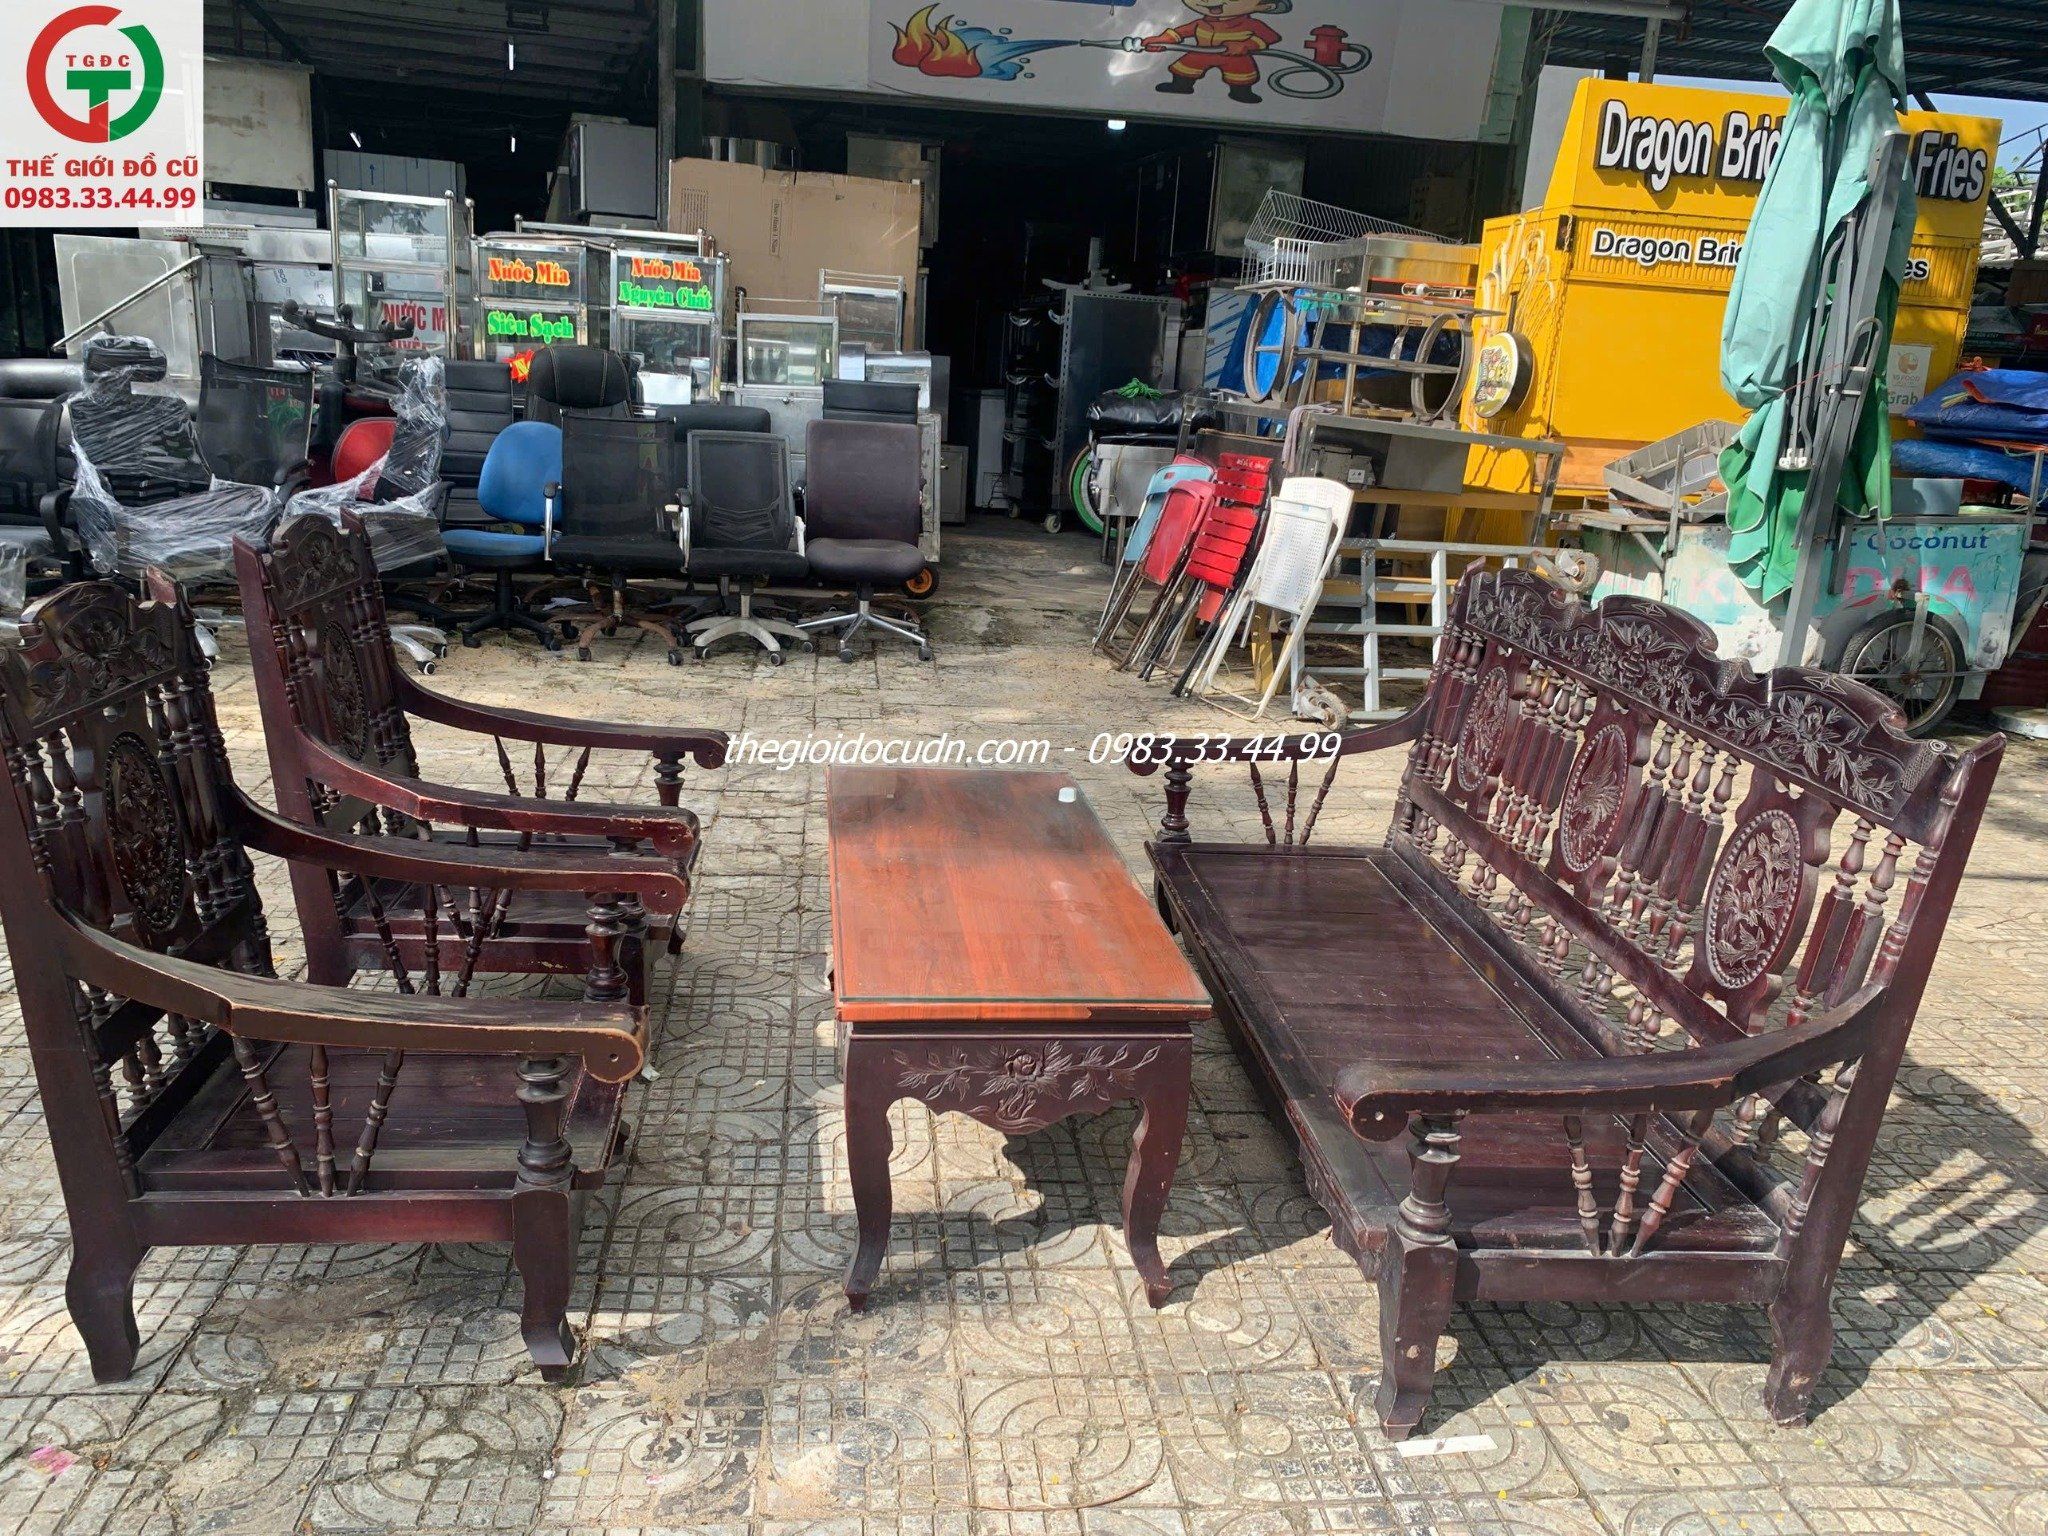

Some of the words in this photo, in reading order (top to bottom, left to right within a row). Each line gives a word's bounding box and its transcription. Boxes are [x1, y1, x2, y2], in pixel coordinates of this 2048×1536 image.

[1599, 99, 1714, 192] Dragon
[1914, 131, 1987, 199] Fries
[1594, 230, 1690, 264] Dragon
[536, 261, 570, 286] Mía
[672, 260, 701, 282] Mía
[619, 282, 675, 308] Nguyên
[676, 286, 712, 310] Chất
[488, 309, 528, 335] Siêu
[530, 312, 574, 344] Sạch
[1867, 533, 1990, 550] Coconut
